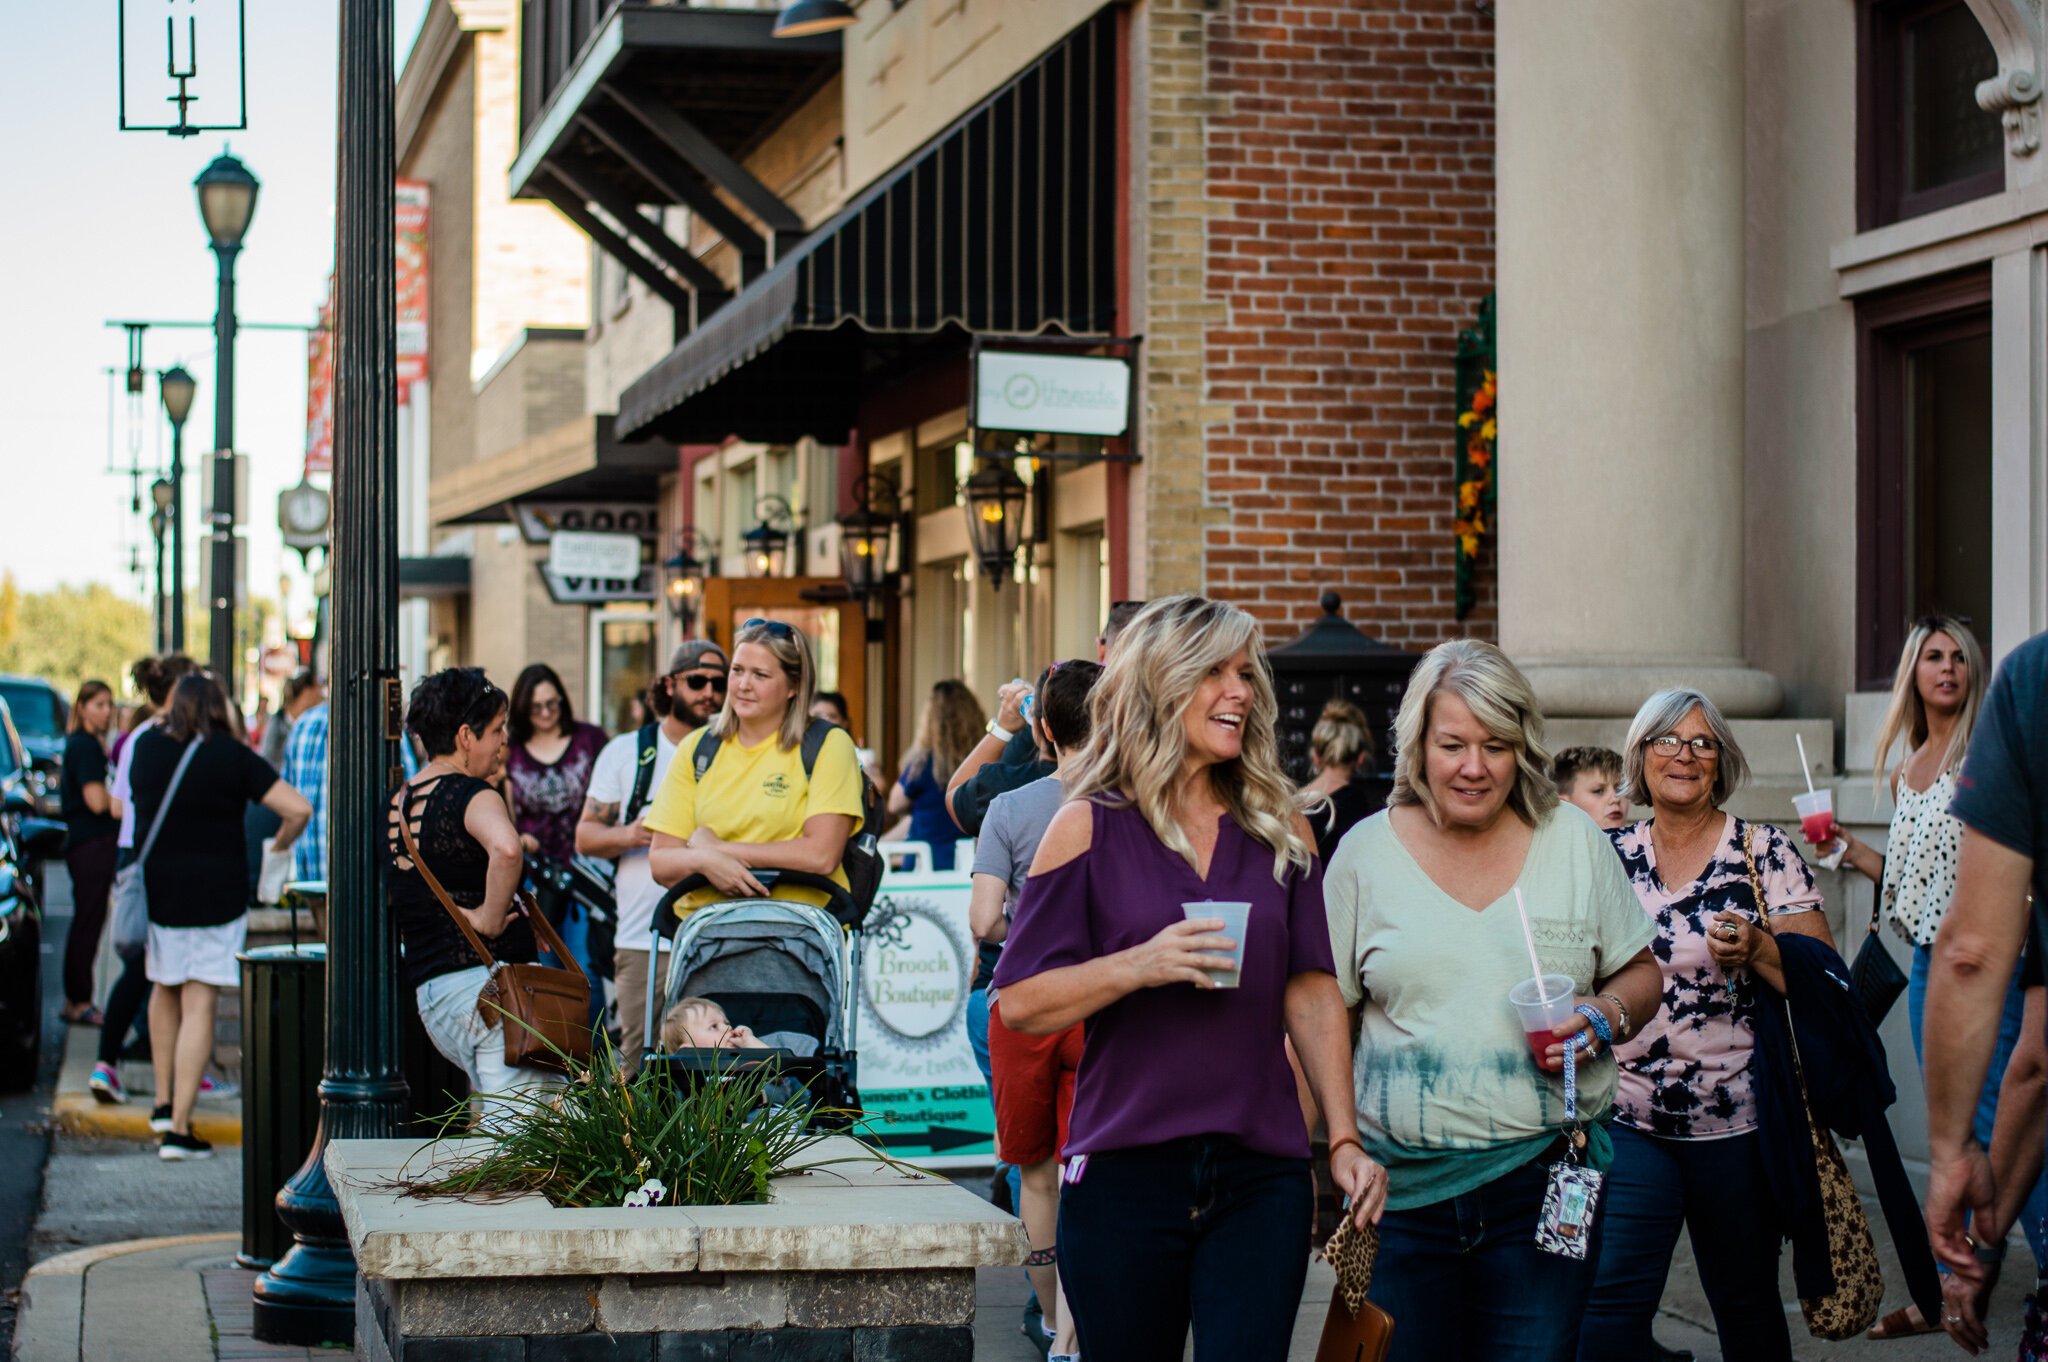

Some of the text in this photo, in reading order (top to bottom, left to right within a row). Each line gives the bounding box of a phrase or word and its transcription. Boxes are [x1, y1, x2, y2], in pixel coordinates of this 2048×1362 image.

[877, 949, 949, 975] Brooch
[872, 980, 956, 1008] Boutique
[861, 1084, 989, 1103] omen's Clothi
[884, 1107, 968, 1123] Boutique
